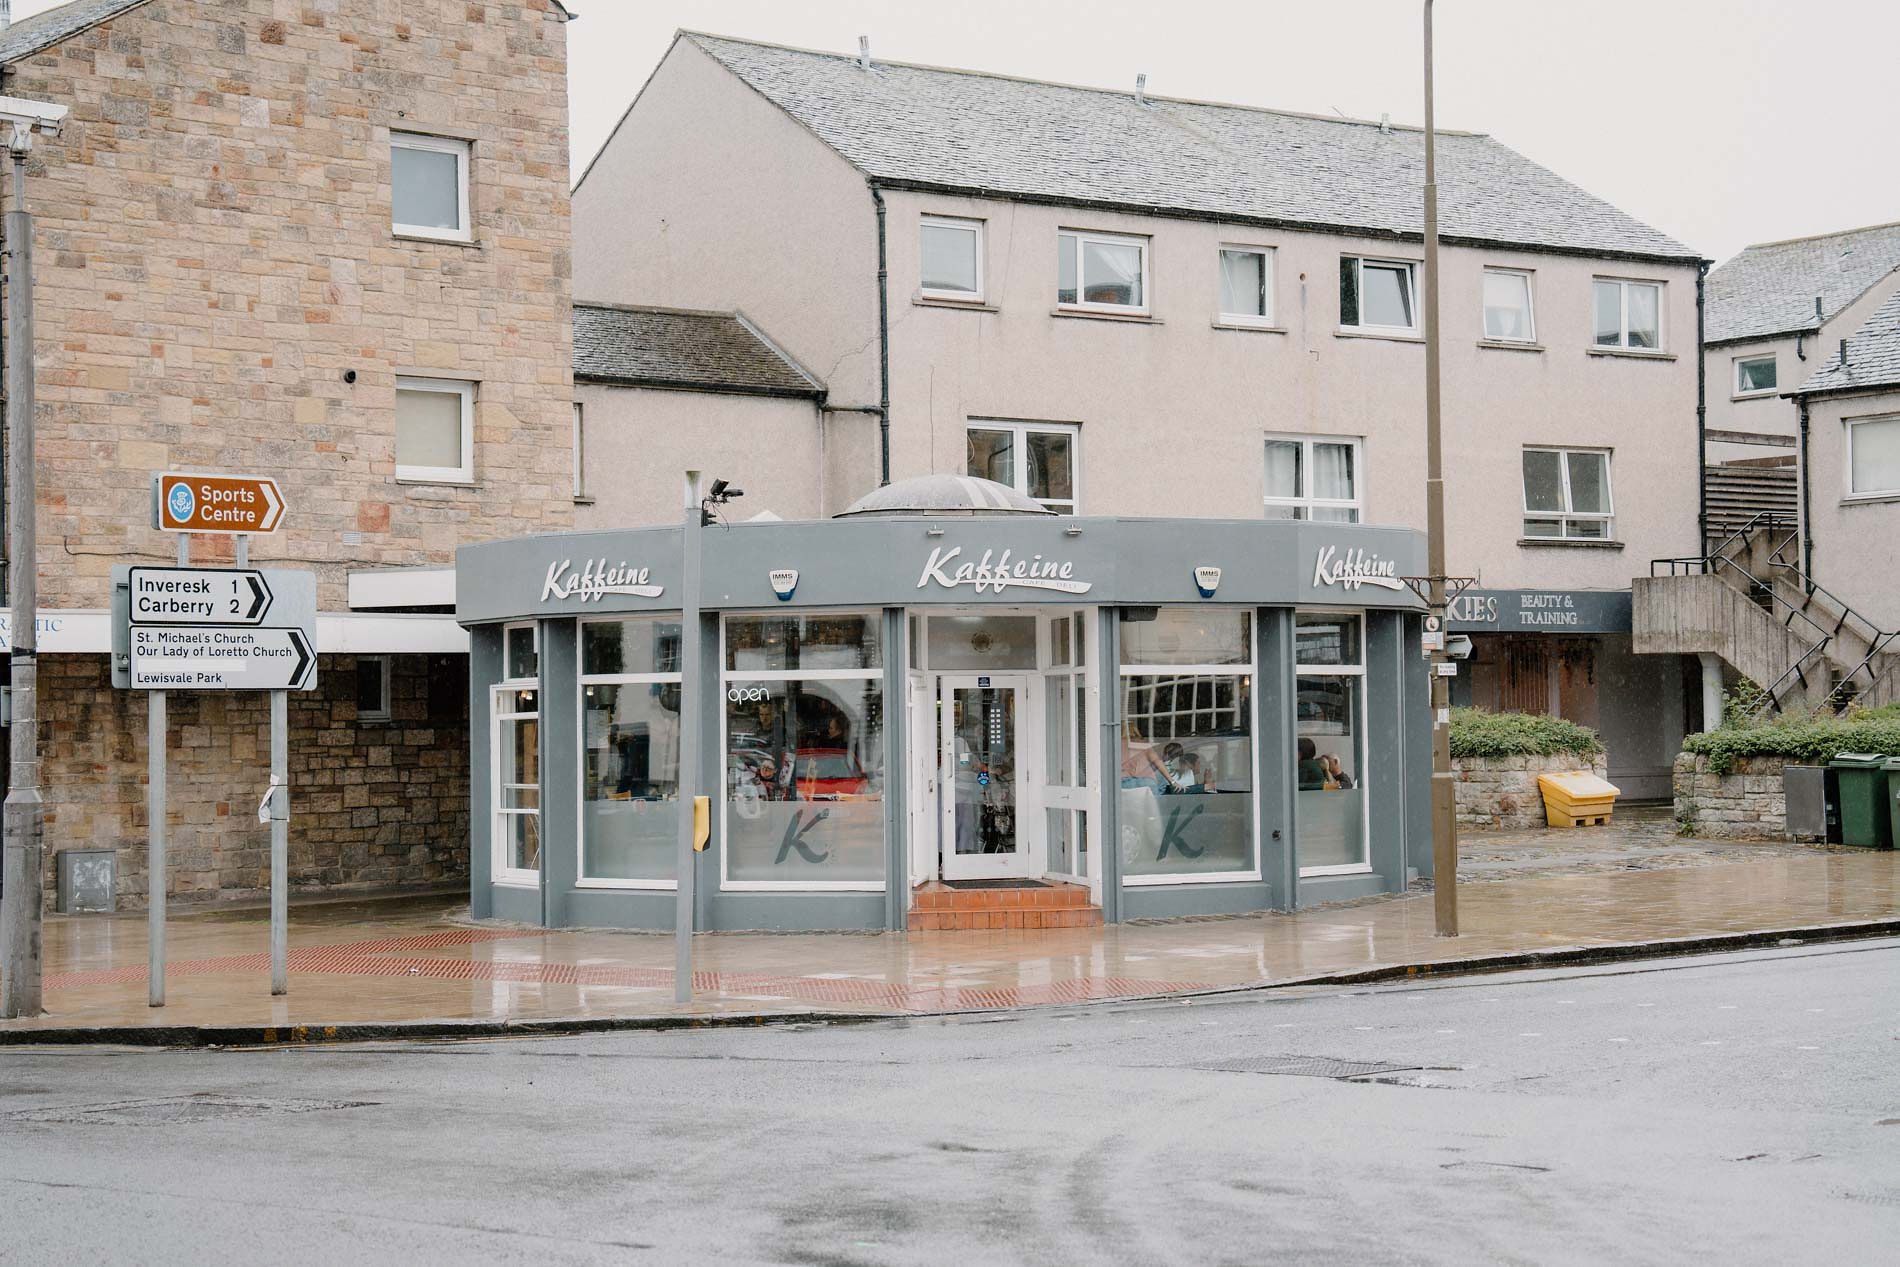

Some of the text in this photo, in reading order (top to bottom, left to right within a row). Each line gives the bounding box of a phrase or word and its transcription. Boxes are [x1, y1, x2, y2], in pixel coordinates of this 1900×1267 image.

[201, 485, 255, 504] Sports
[201, 505, 256, 523] Centre
[917, 546, 1074, 594] Kaffeine
[1313, 545, 1395, 590] Kaffeine
[139, 577, 238, 594] Inveresk 1
[541, 558, 649, 602] Kaffeine
[138, 597, 240, 616] Carberry 2
[1520, 594, 1574, 608] BEAUTY &
[1519, 611, 1578, 625] TRAINING
[137, 632, 254, 644] St. Michael's Church
[137, 645, 292, 659] Our Lady of Loretto Church
[137, 673, 222, 683] Lewisvale Park
[728, 687, 770, 705] open
[774, 807, 830, 865] K
[1156, 803, 1205, 862] K
